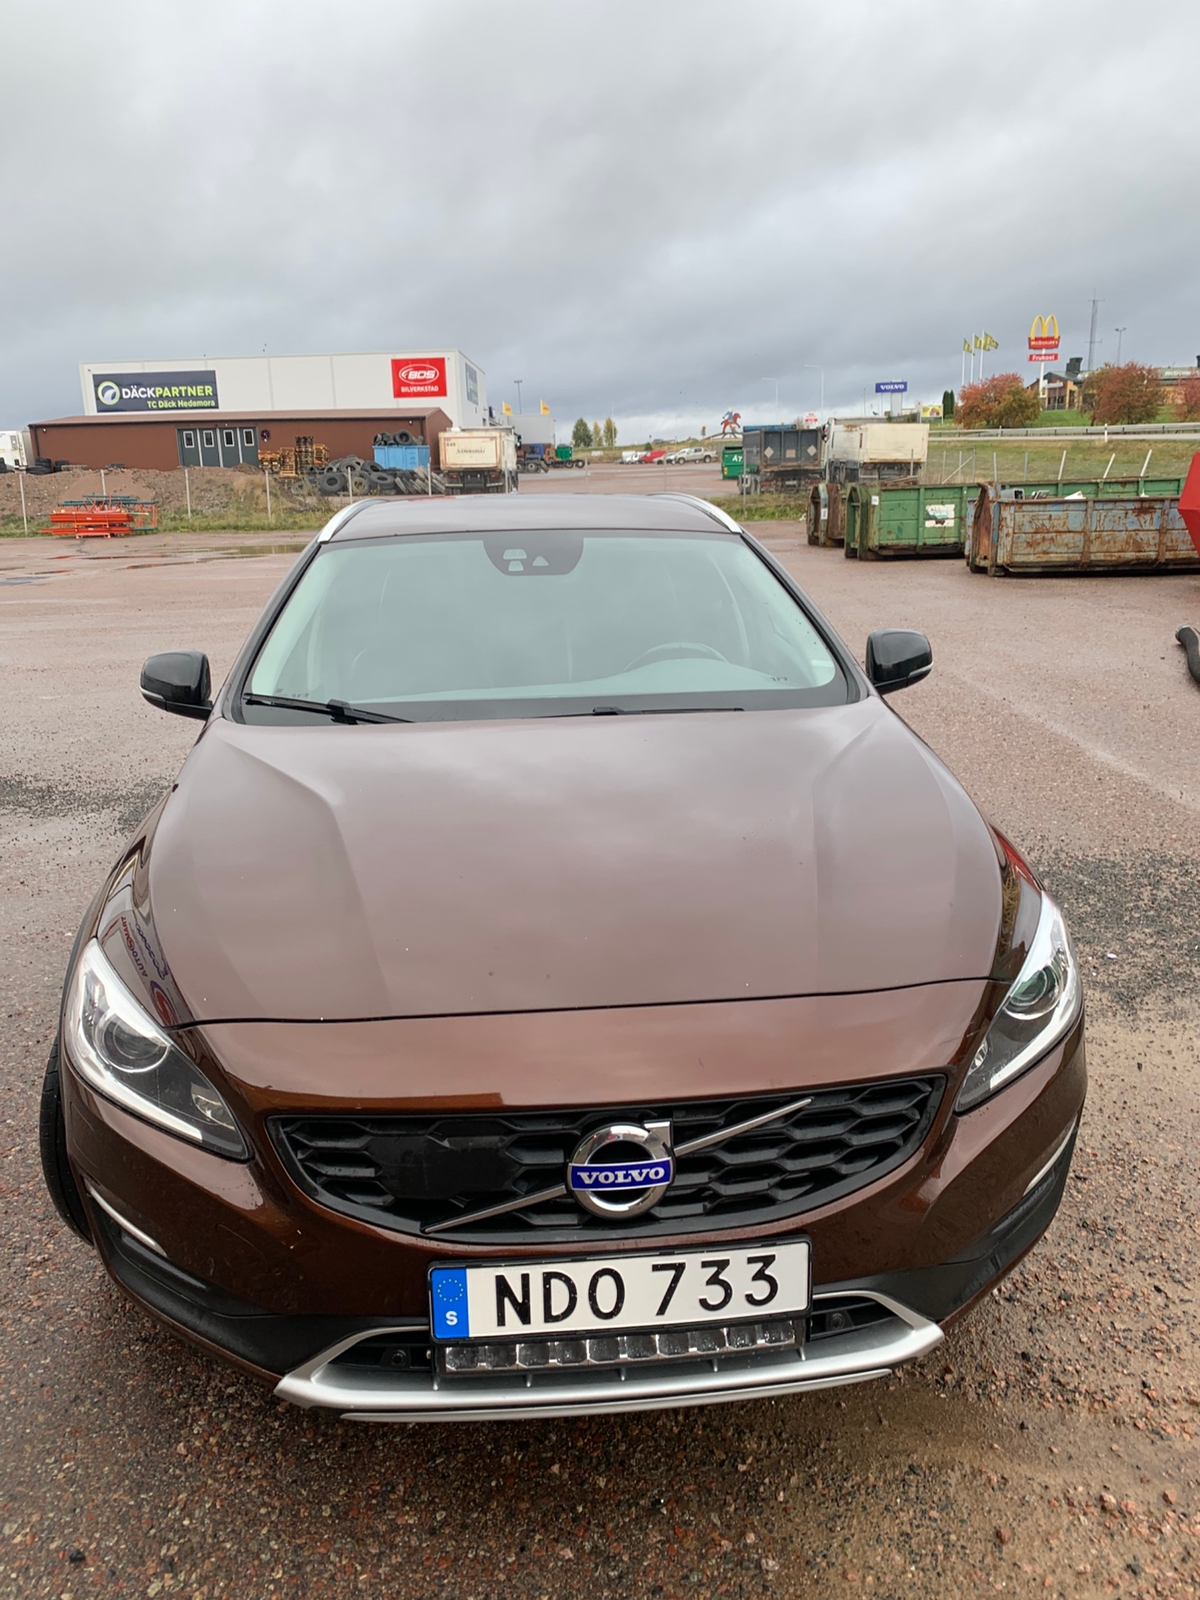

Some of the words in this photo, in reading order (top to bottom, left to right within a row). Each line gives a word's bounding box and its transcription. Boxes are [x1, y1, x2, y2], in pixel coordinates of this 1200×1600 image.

[121, 385, 213, 399] DÄCKPARTNER
[577, 1167, 665, 1184] VOLVO
[495, 1268, 626, 1327] NDO
[651, 1254, 779, 1316] 733
[445, 1311, 458, 1326] S
